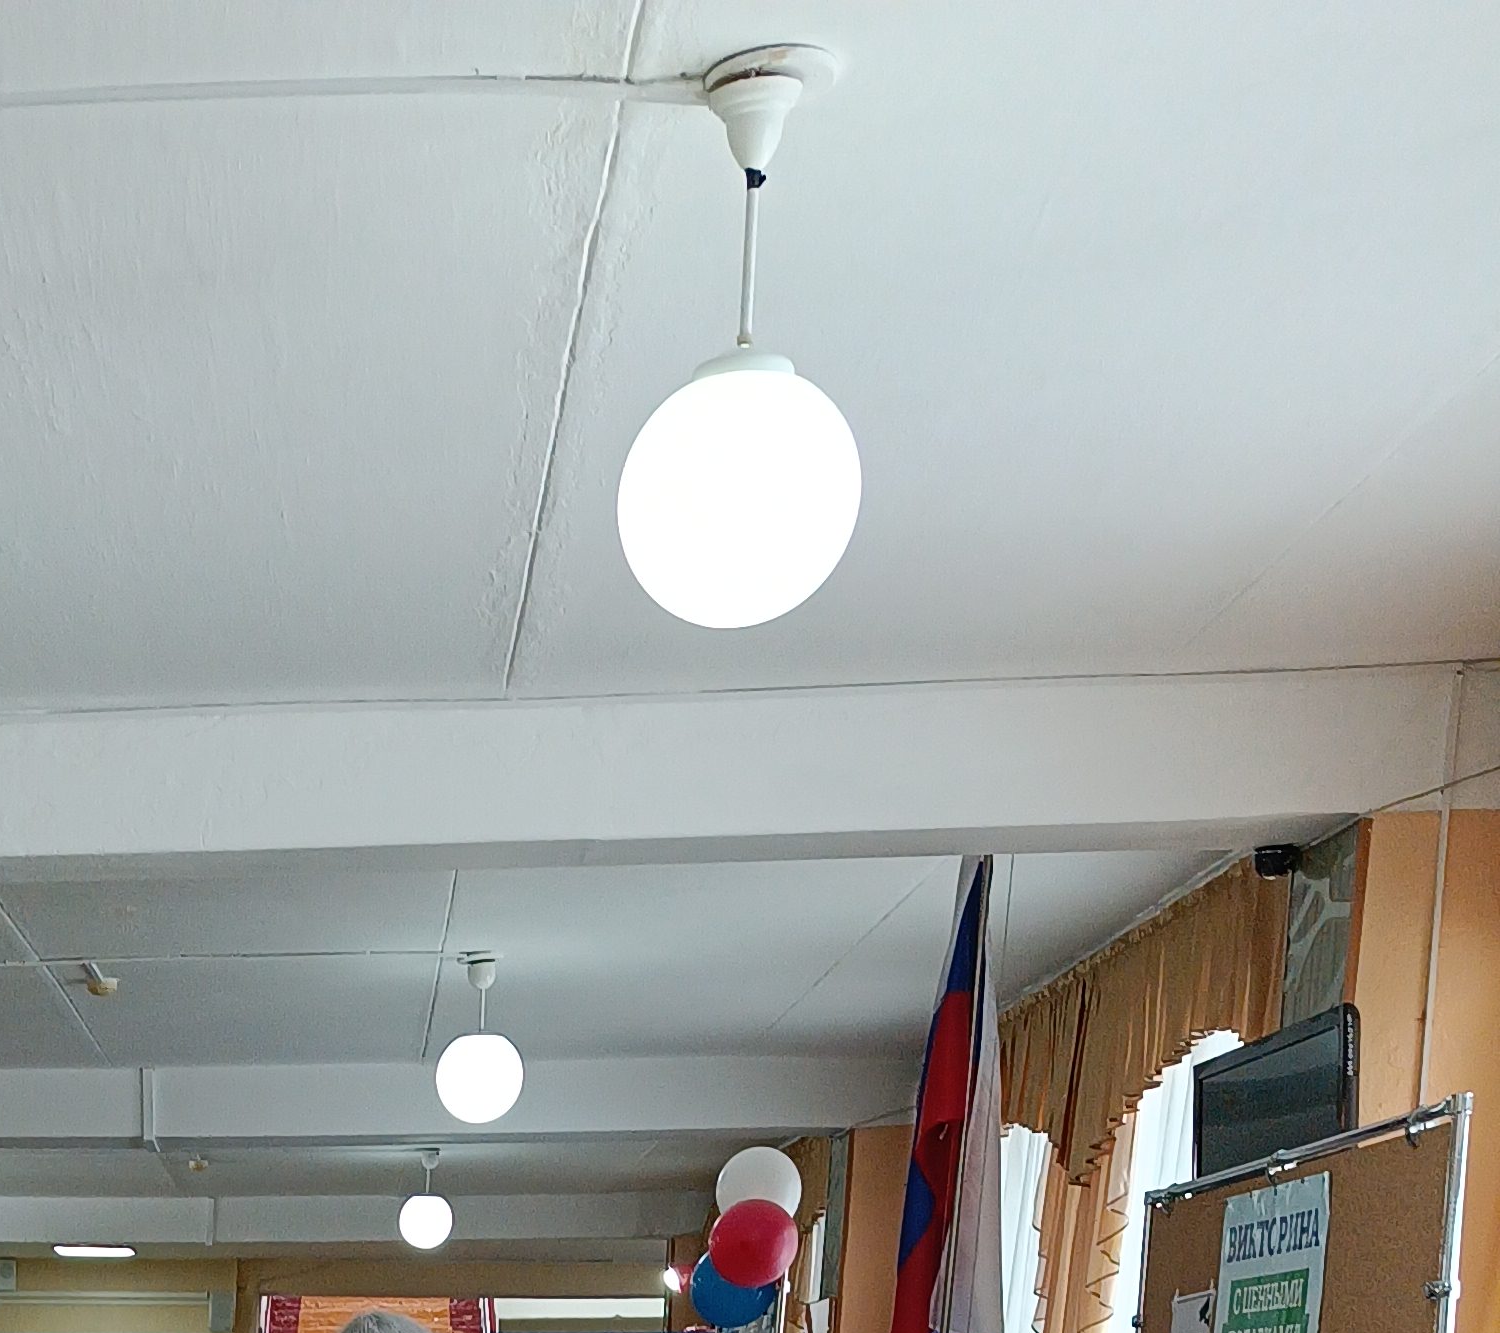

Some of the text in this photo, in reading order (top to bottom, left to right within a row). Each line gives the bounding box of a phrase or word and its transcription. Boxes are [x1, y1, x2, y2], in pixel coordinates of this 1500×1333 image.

[1226, 1207, 1320, 1263] ВИКТОРИНА
[1233, 1278, 1304, 1319] С ЦЕННЫМИ
